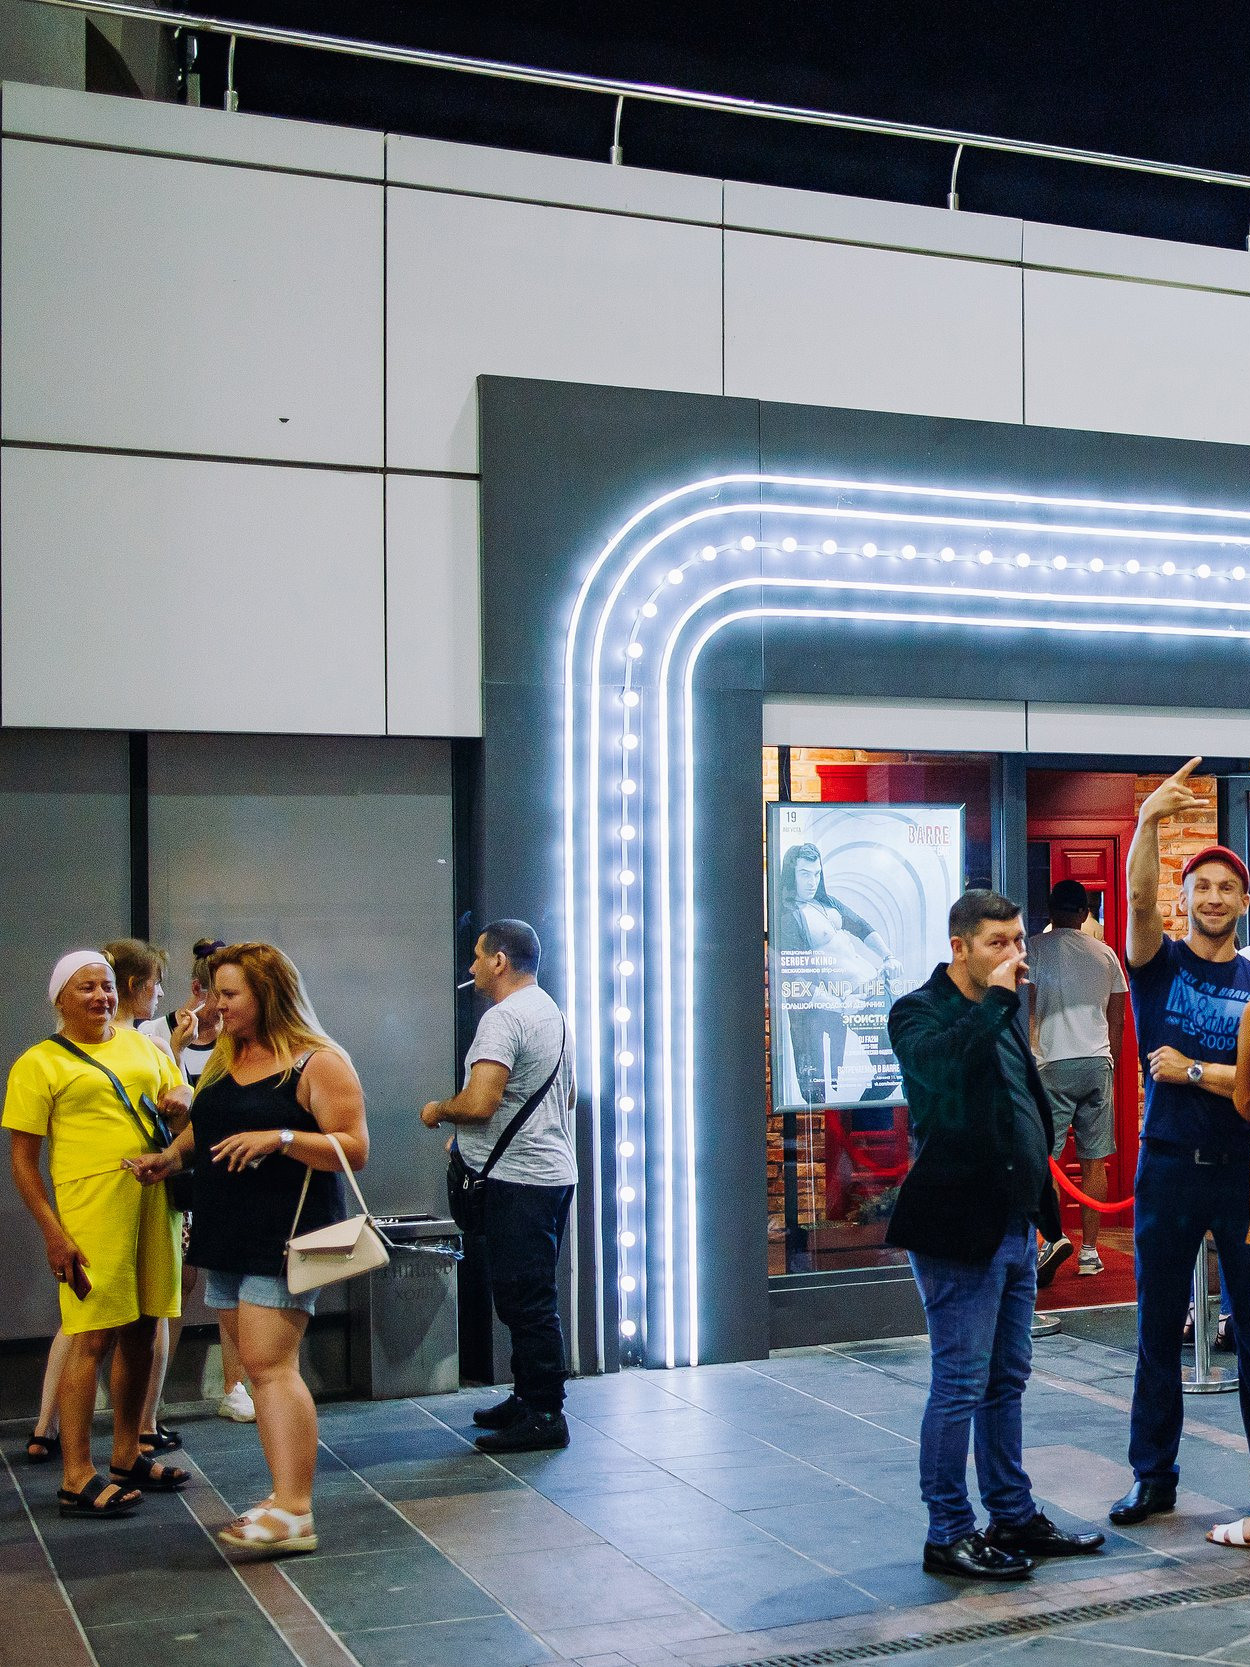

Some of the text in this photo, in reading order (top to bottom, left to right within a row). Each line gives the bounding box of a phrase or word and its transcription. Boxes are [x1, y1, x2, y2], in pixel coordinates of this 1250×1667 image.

[786, 811, 797, 823] 19
[908, 825, 950, 844] BARRE
[781, 956, 810, 967] SERGEY
[782, 981, 812, 997] SEX
[817, 980, 852, 997] AND
[857, 980, 885, 996] THE
[782, 1002, 814, 1010] БОЛЬШОЙ
[842, 1014, 888, 1024] ЭГОИСТК
[1199, 1032, 1236, 1051] 2009
